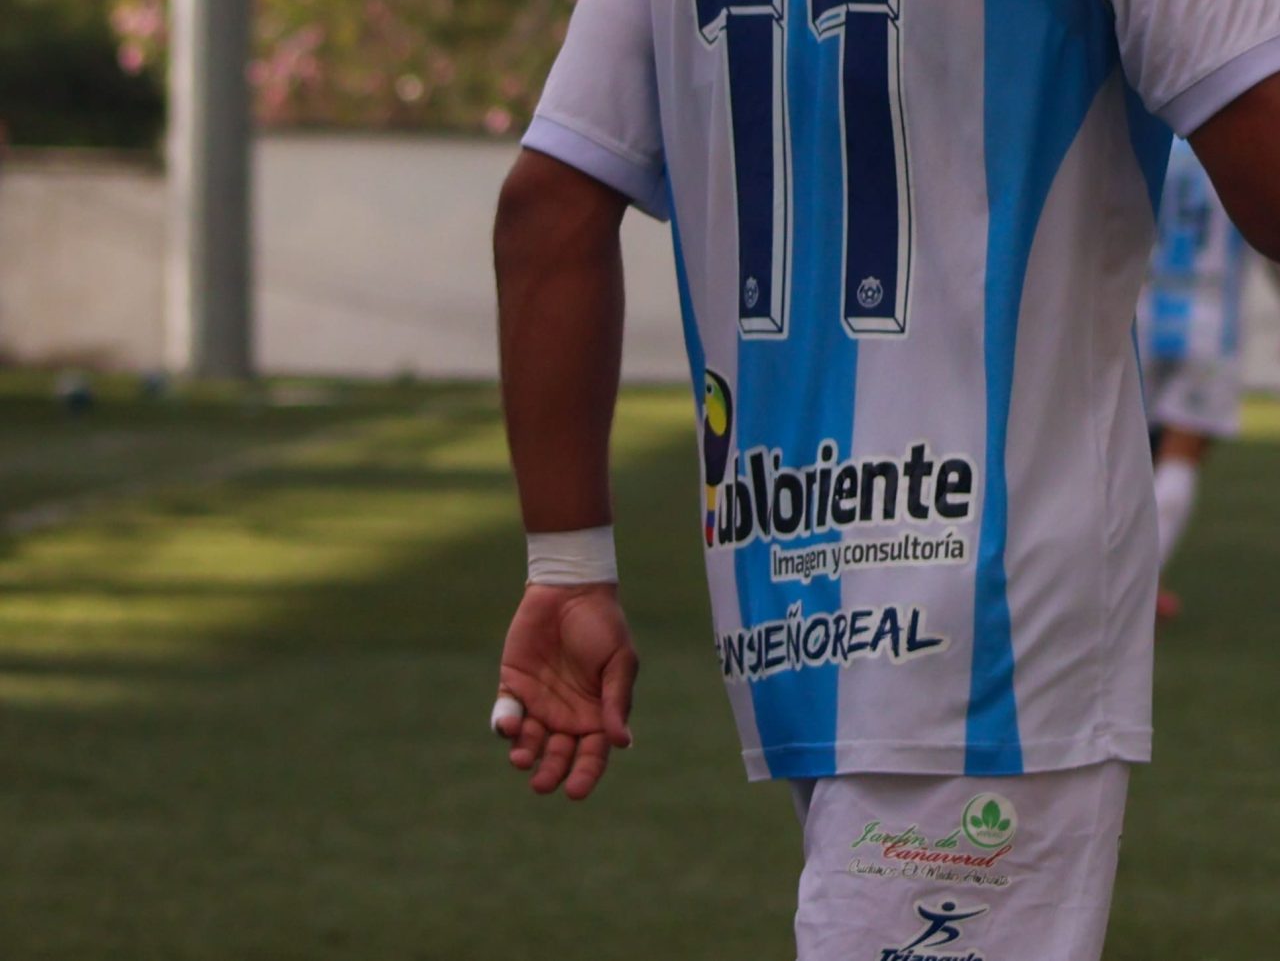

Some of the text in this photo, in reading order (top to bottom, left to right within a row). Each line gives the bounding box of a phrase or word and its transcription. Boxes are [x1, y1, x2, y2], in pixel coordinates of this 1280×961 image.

[772, 533, 964, 578] Imagen y consultoría
[934, 829, 961, 849] de
